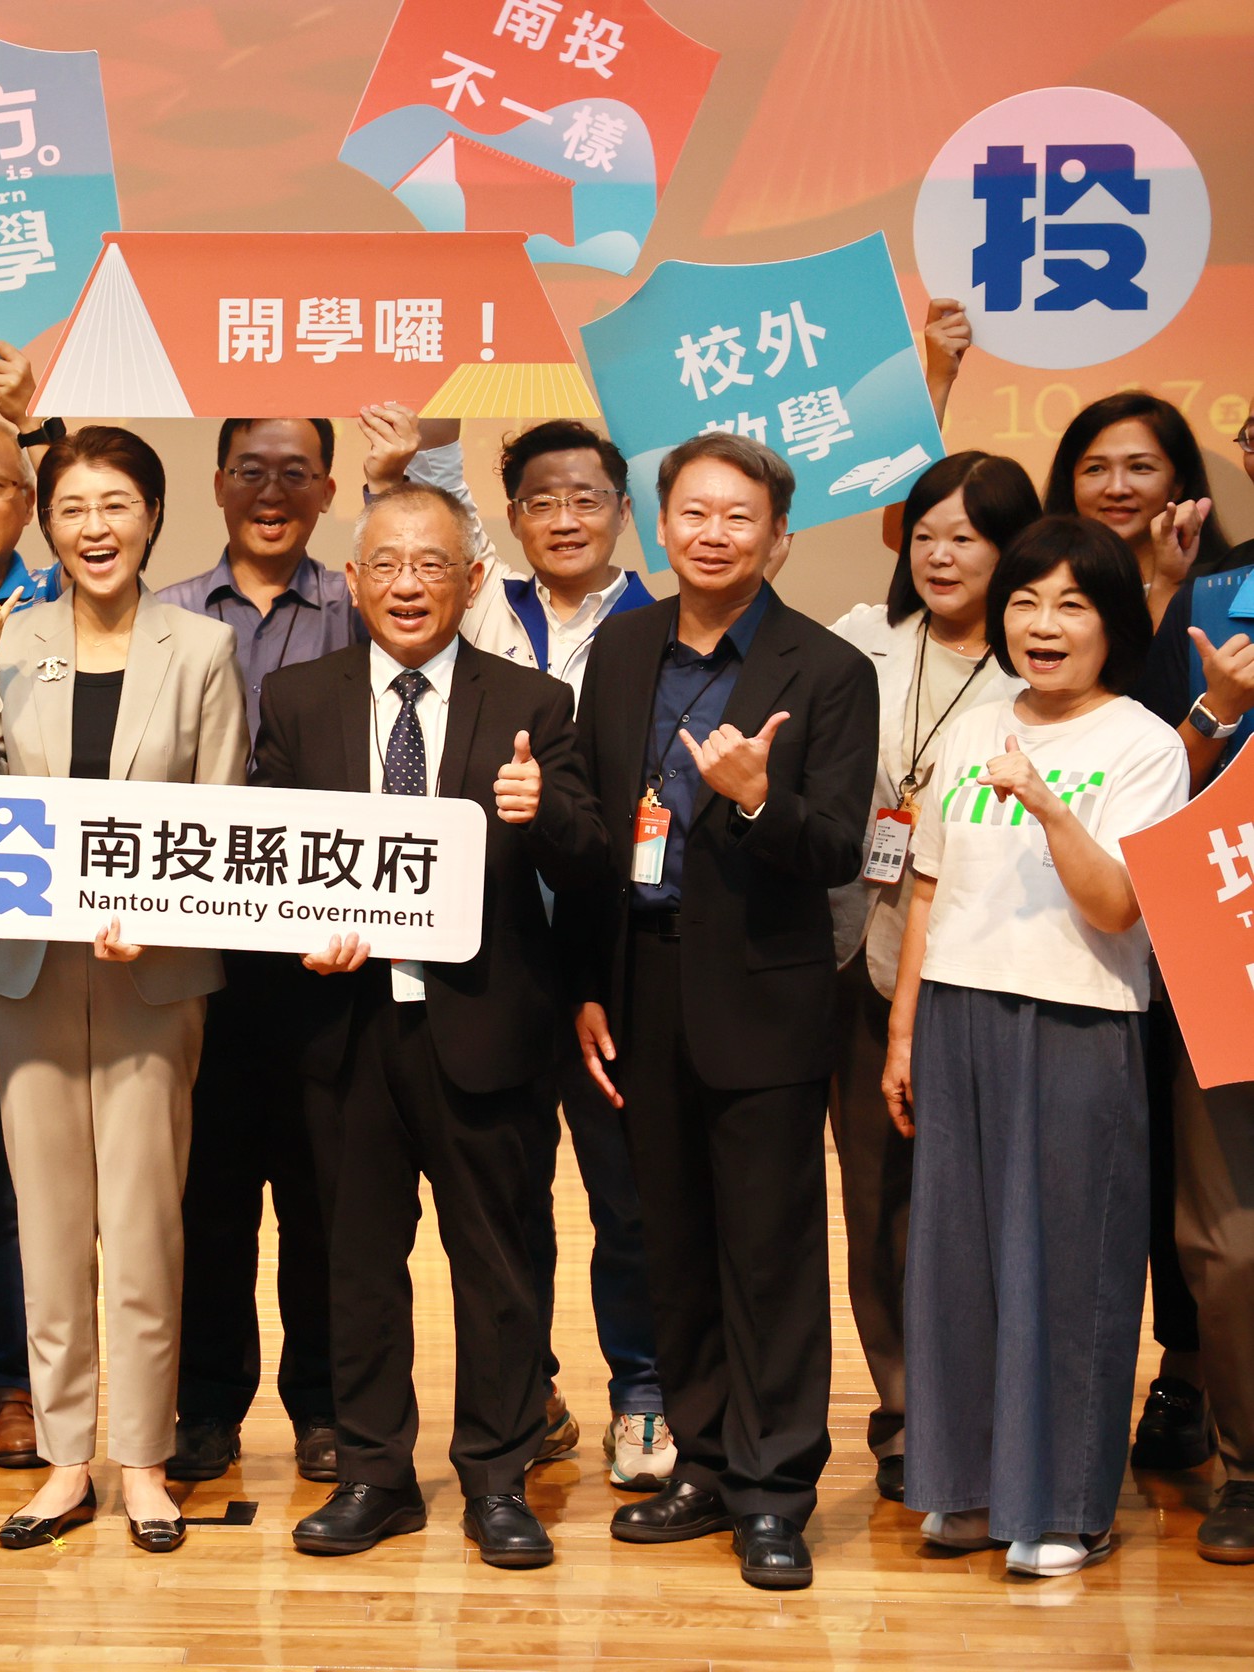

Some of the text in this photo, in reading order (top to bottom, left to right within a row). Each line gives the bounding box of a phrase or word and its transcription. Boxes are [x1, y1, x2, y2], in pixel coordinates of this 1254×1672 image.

[490, 0, 625, 80] 南投
[430, 50, 629, 173] 不一樣
[6, 165, 33, 180] is
[972, 145, 1150, 311] 投
[219, 297, 494, 363] 開學囉！
[675, 301, 827, 401] 校外
[79, 816, 438, 895] 南投縣政府
[79, 890, 435, 928] Nantou County Government
